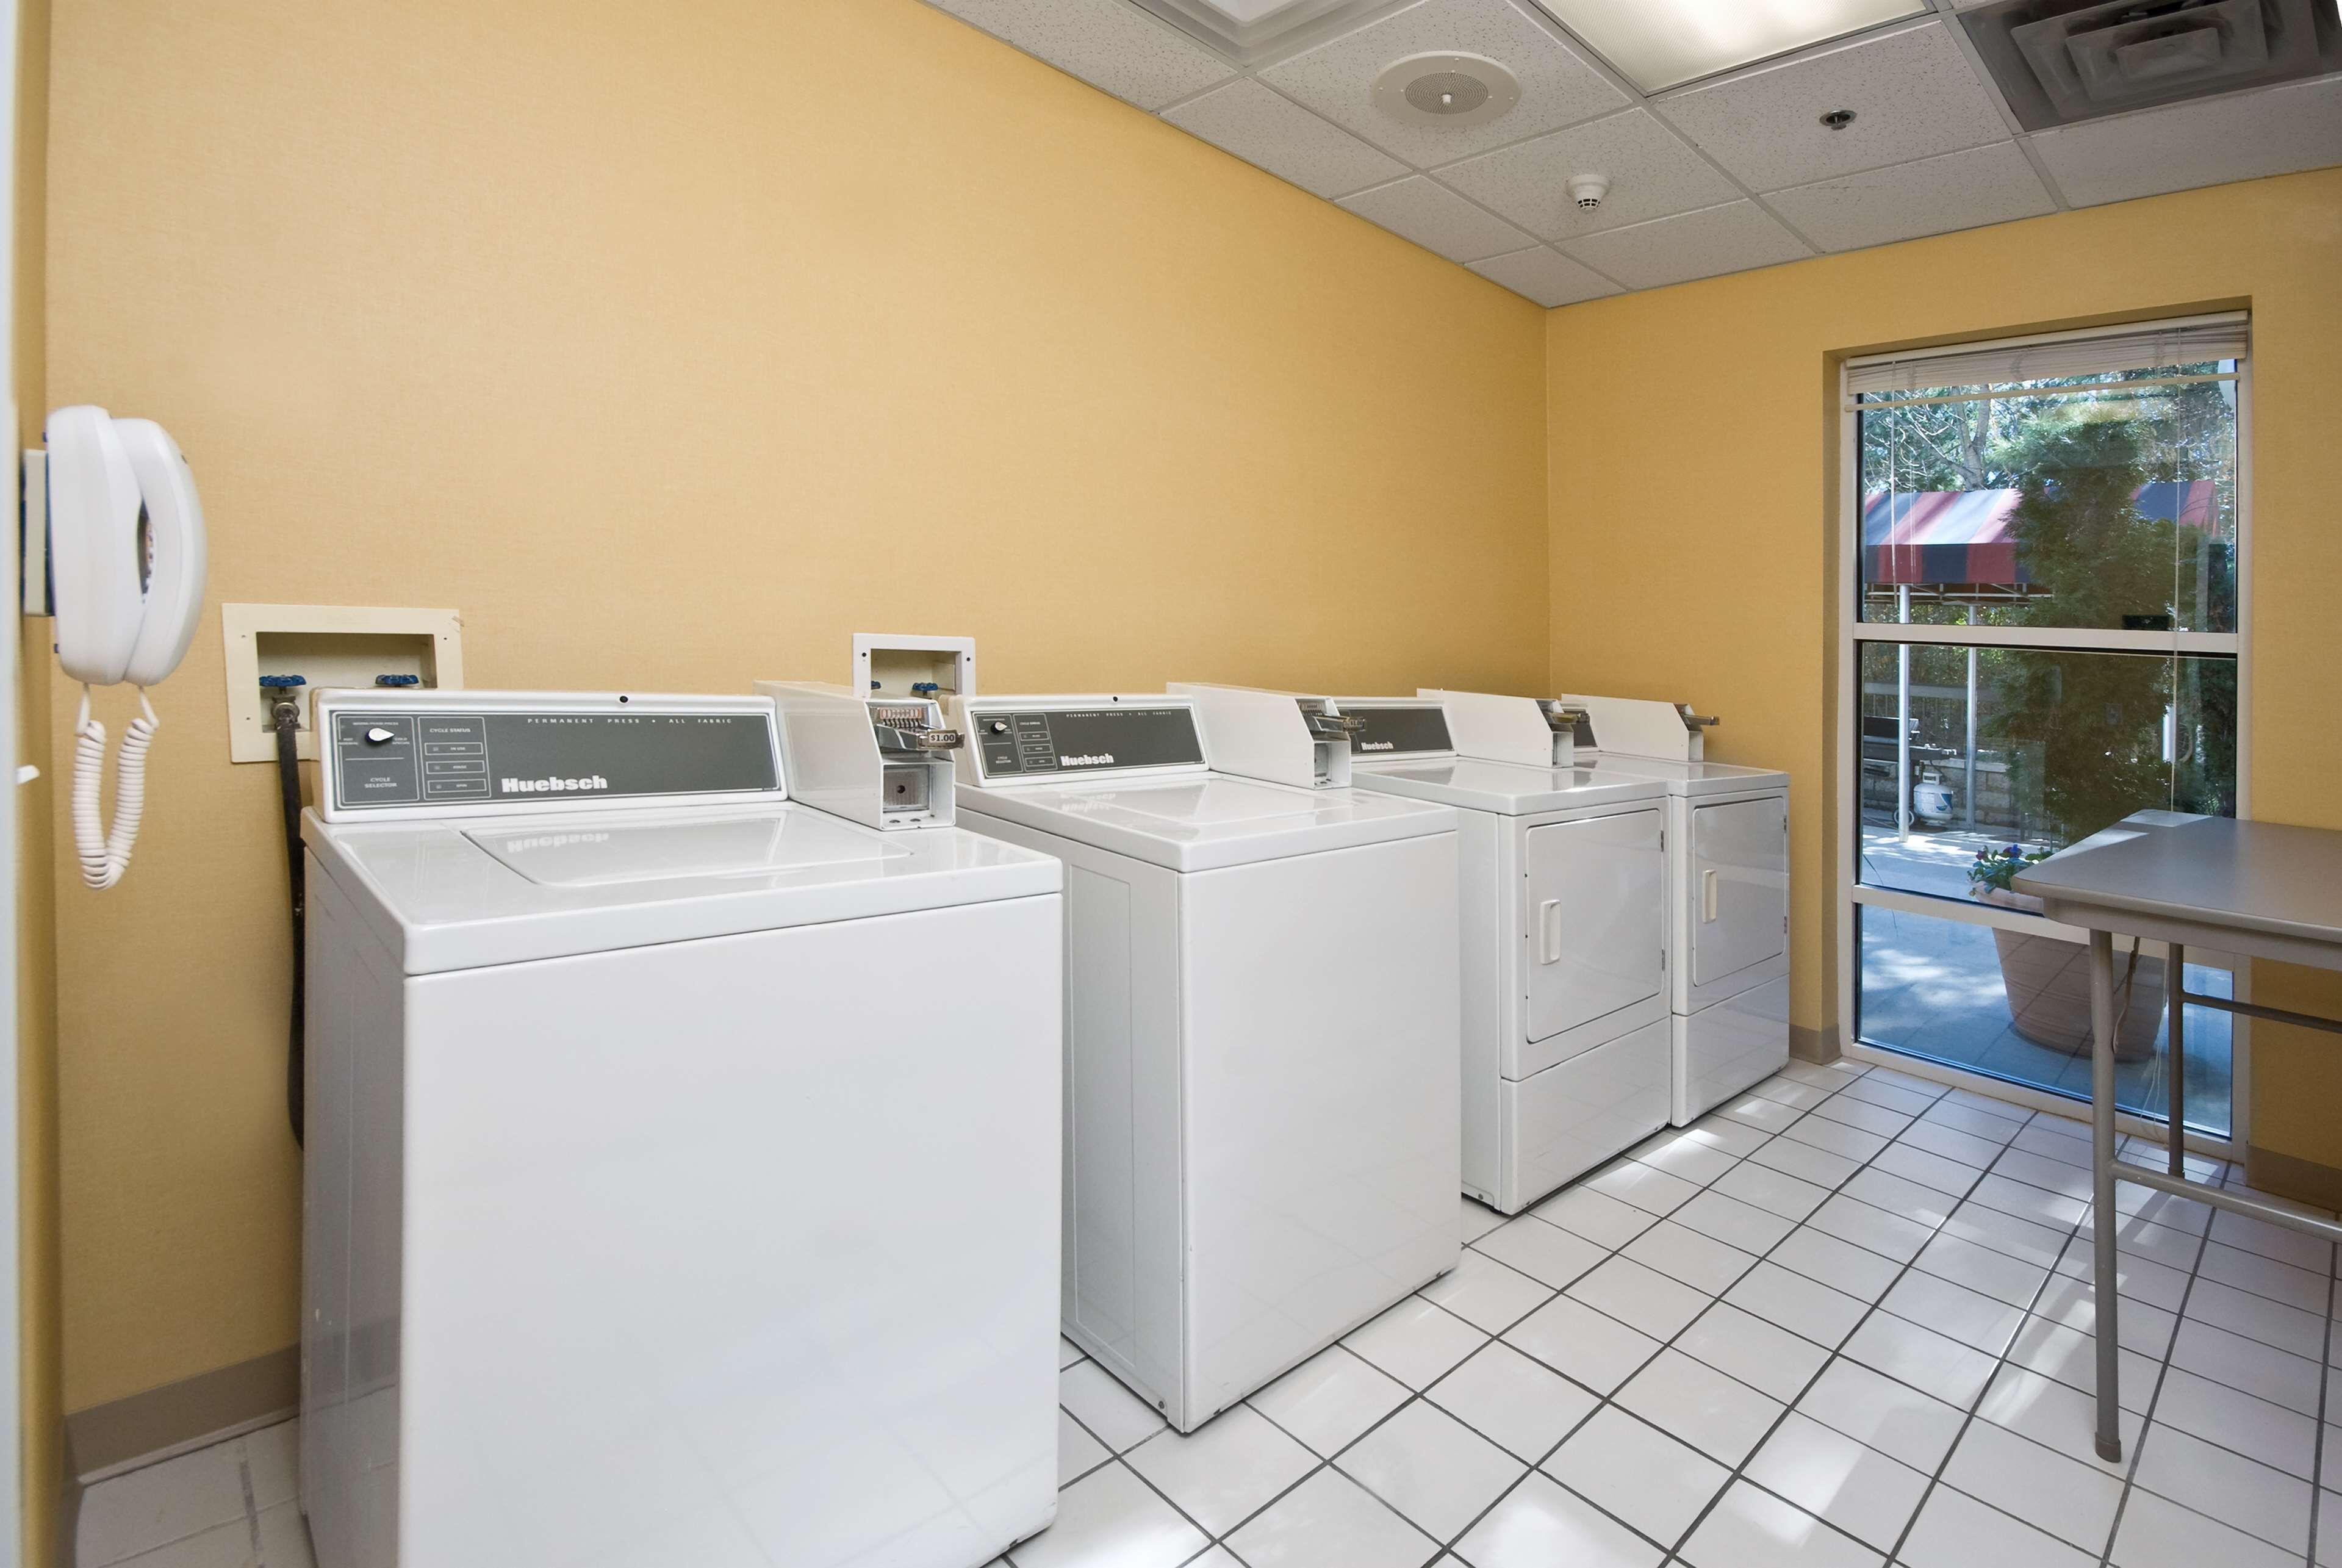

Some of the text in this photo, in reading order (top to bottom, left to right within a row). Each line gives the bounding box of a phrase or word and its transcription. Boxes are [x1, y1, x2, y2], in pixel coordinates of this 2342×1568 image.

[1361, 741, 1394, 750] Huebsch
[1060, 753, 1114, 766] Huebsch
[501, 775, 608, 793] Huebsch
